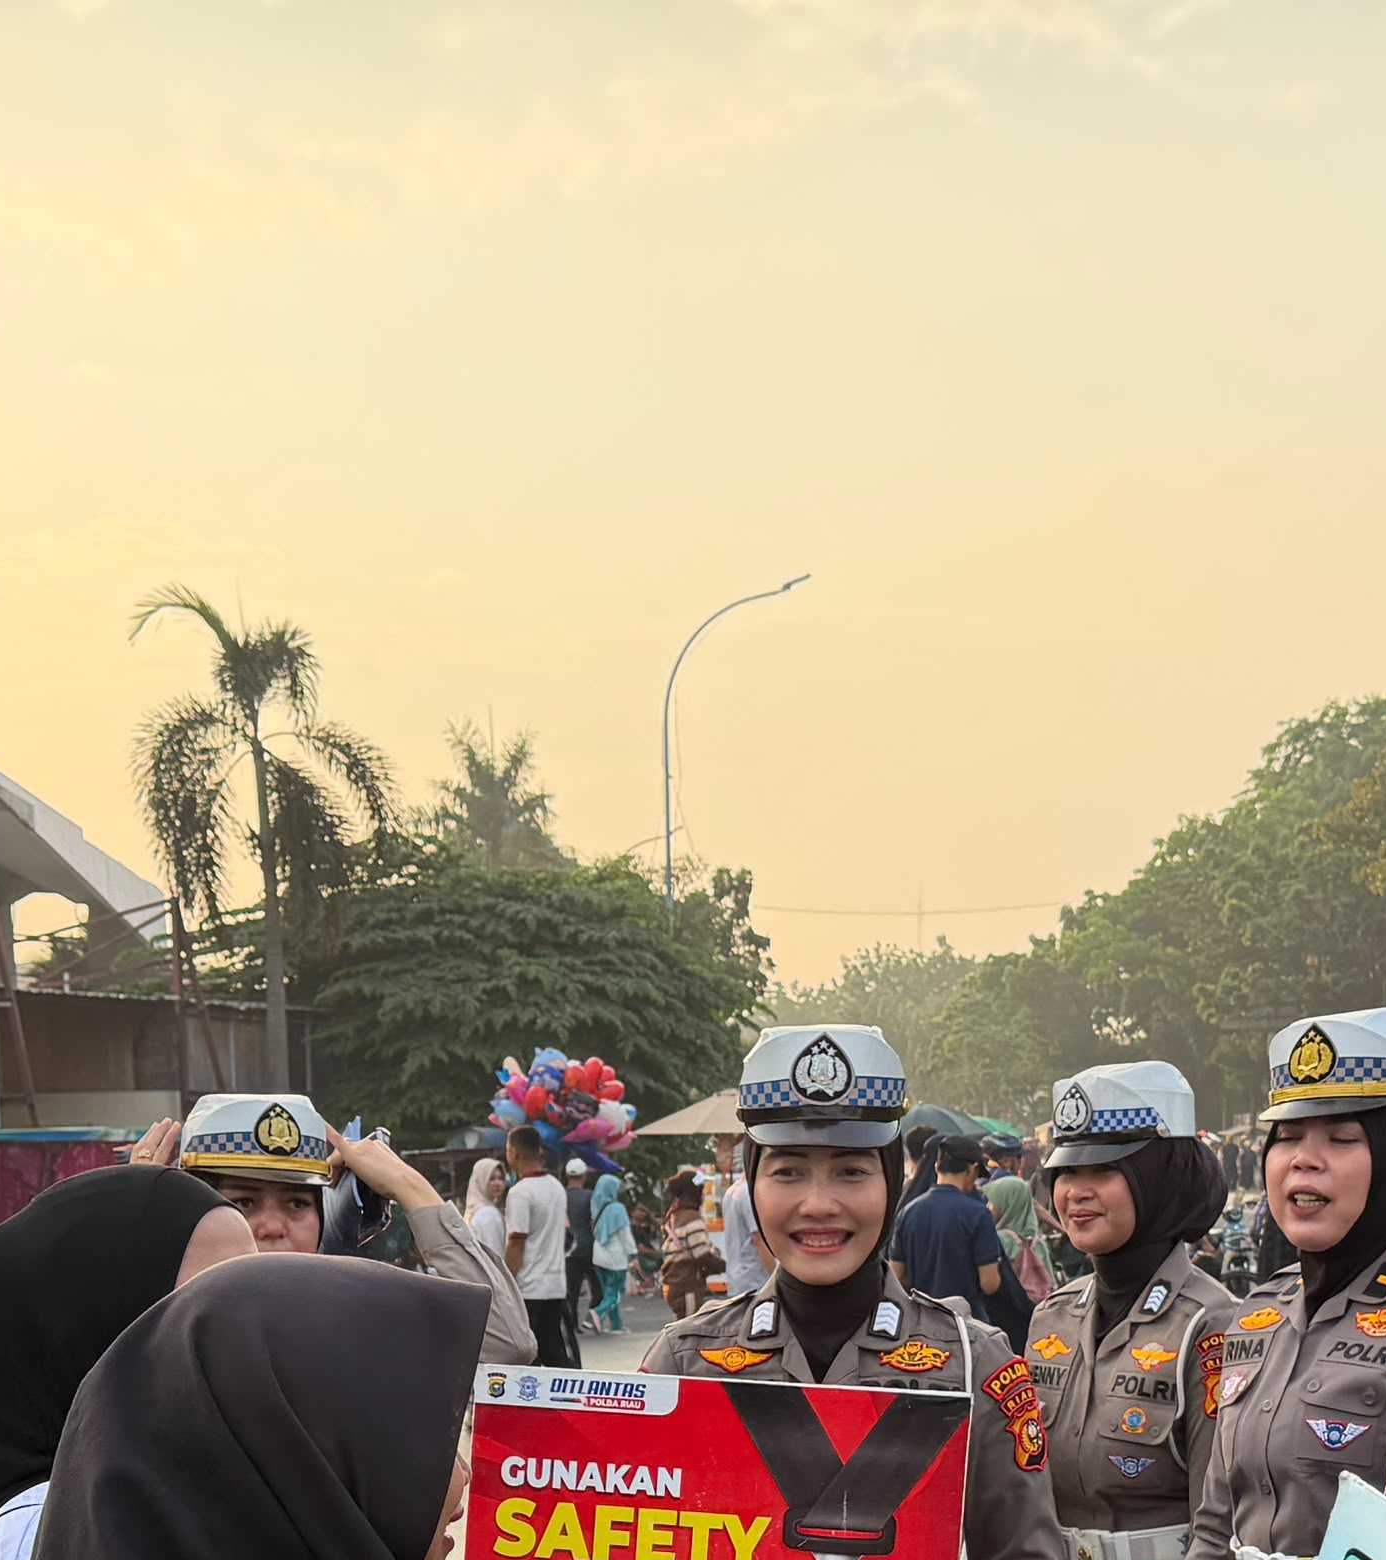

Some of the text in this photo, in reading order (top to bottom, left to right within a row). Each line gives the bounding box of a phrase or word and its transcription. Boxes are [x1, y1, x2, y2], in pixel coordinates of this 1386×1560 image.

[1033, 1366, 1068, 1386] ENNY
[550, 1378, 647, 1399] DITLANTAS
[1111, 1374, 1175, 1400] POLRI
[589, 1398, 619, 1408] POLDA
[501, 1456, 683, 1498] GUNAKAN
